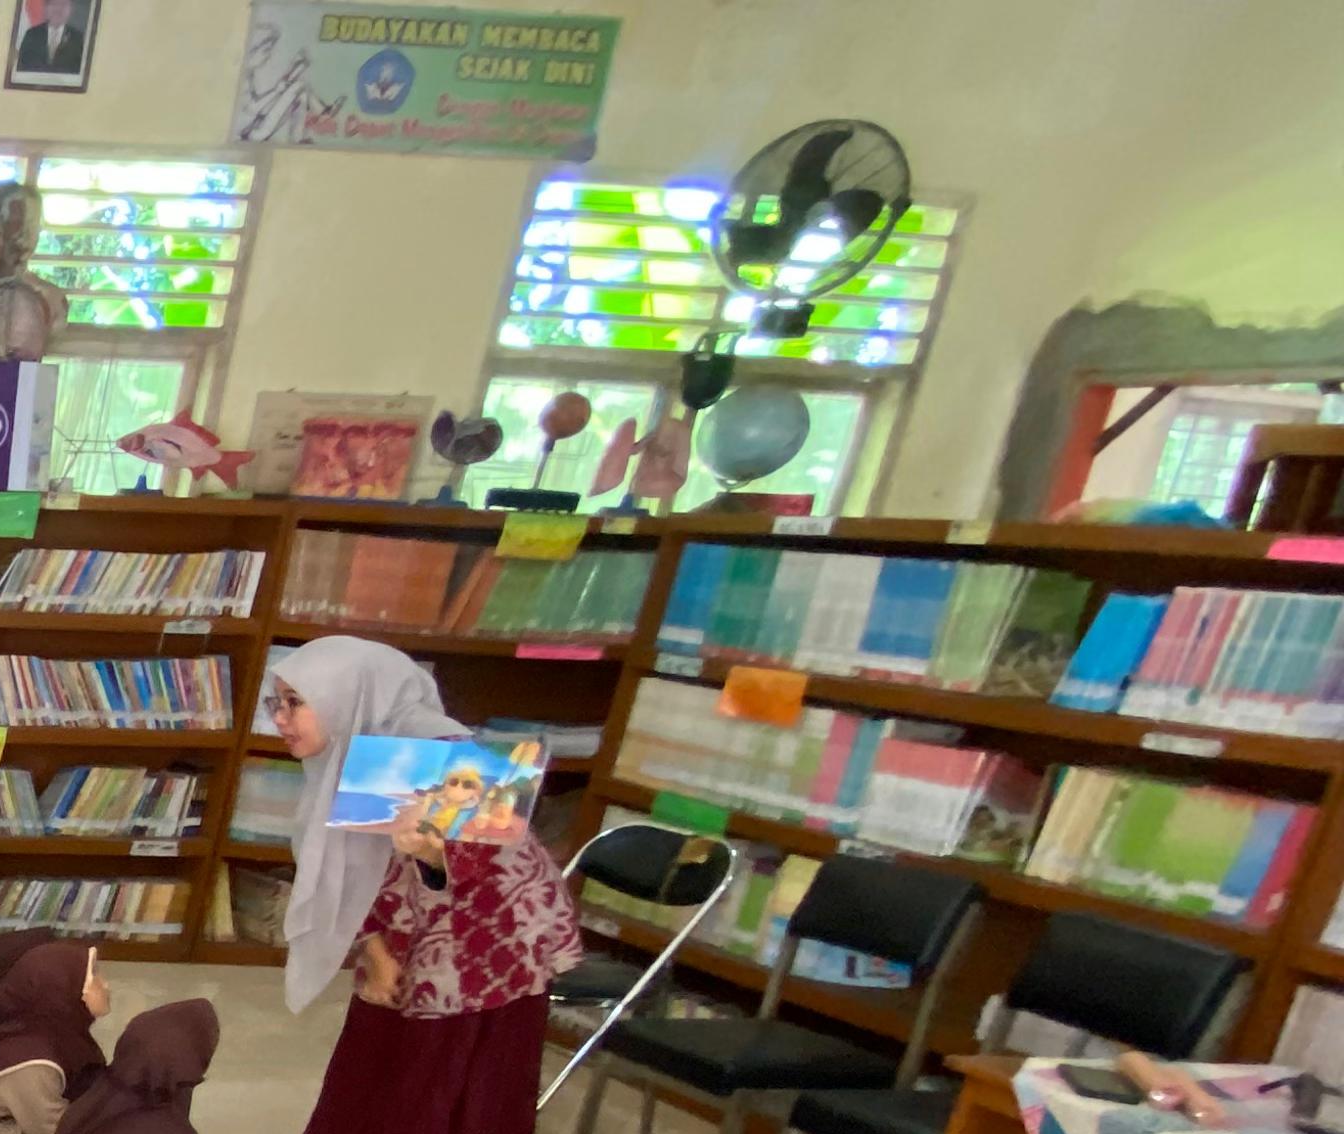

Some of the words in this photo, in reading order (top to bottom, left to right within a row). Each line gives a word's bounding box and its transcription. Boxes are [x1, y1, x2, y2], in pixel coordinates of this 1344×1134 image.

[319, 15, 469, 47] BUDAYAKAN
[480, 23, 600, 52] MEMBACA
[458, 54, 531, 81] SEJAK
[543, 59, 595, 85] DINI
